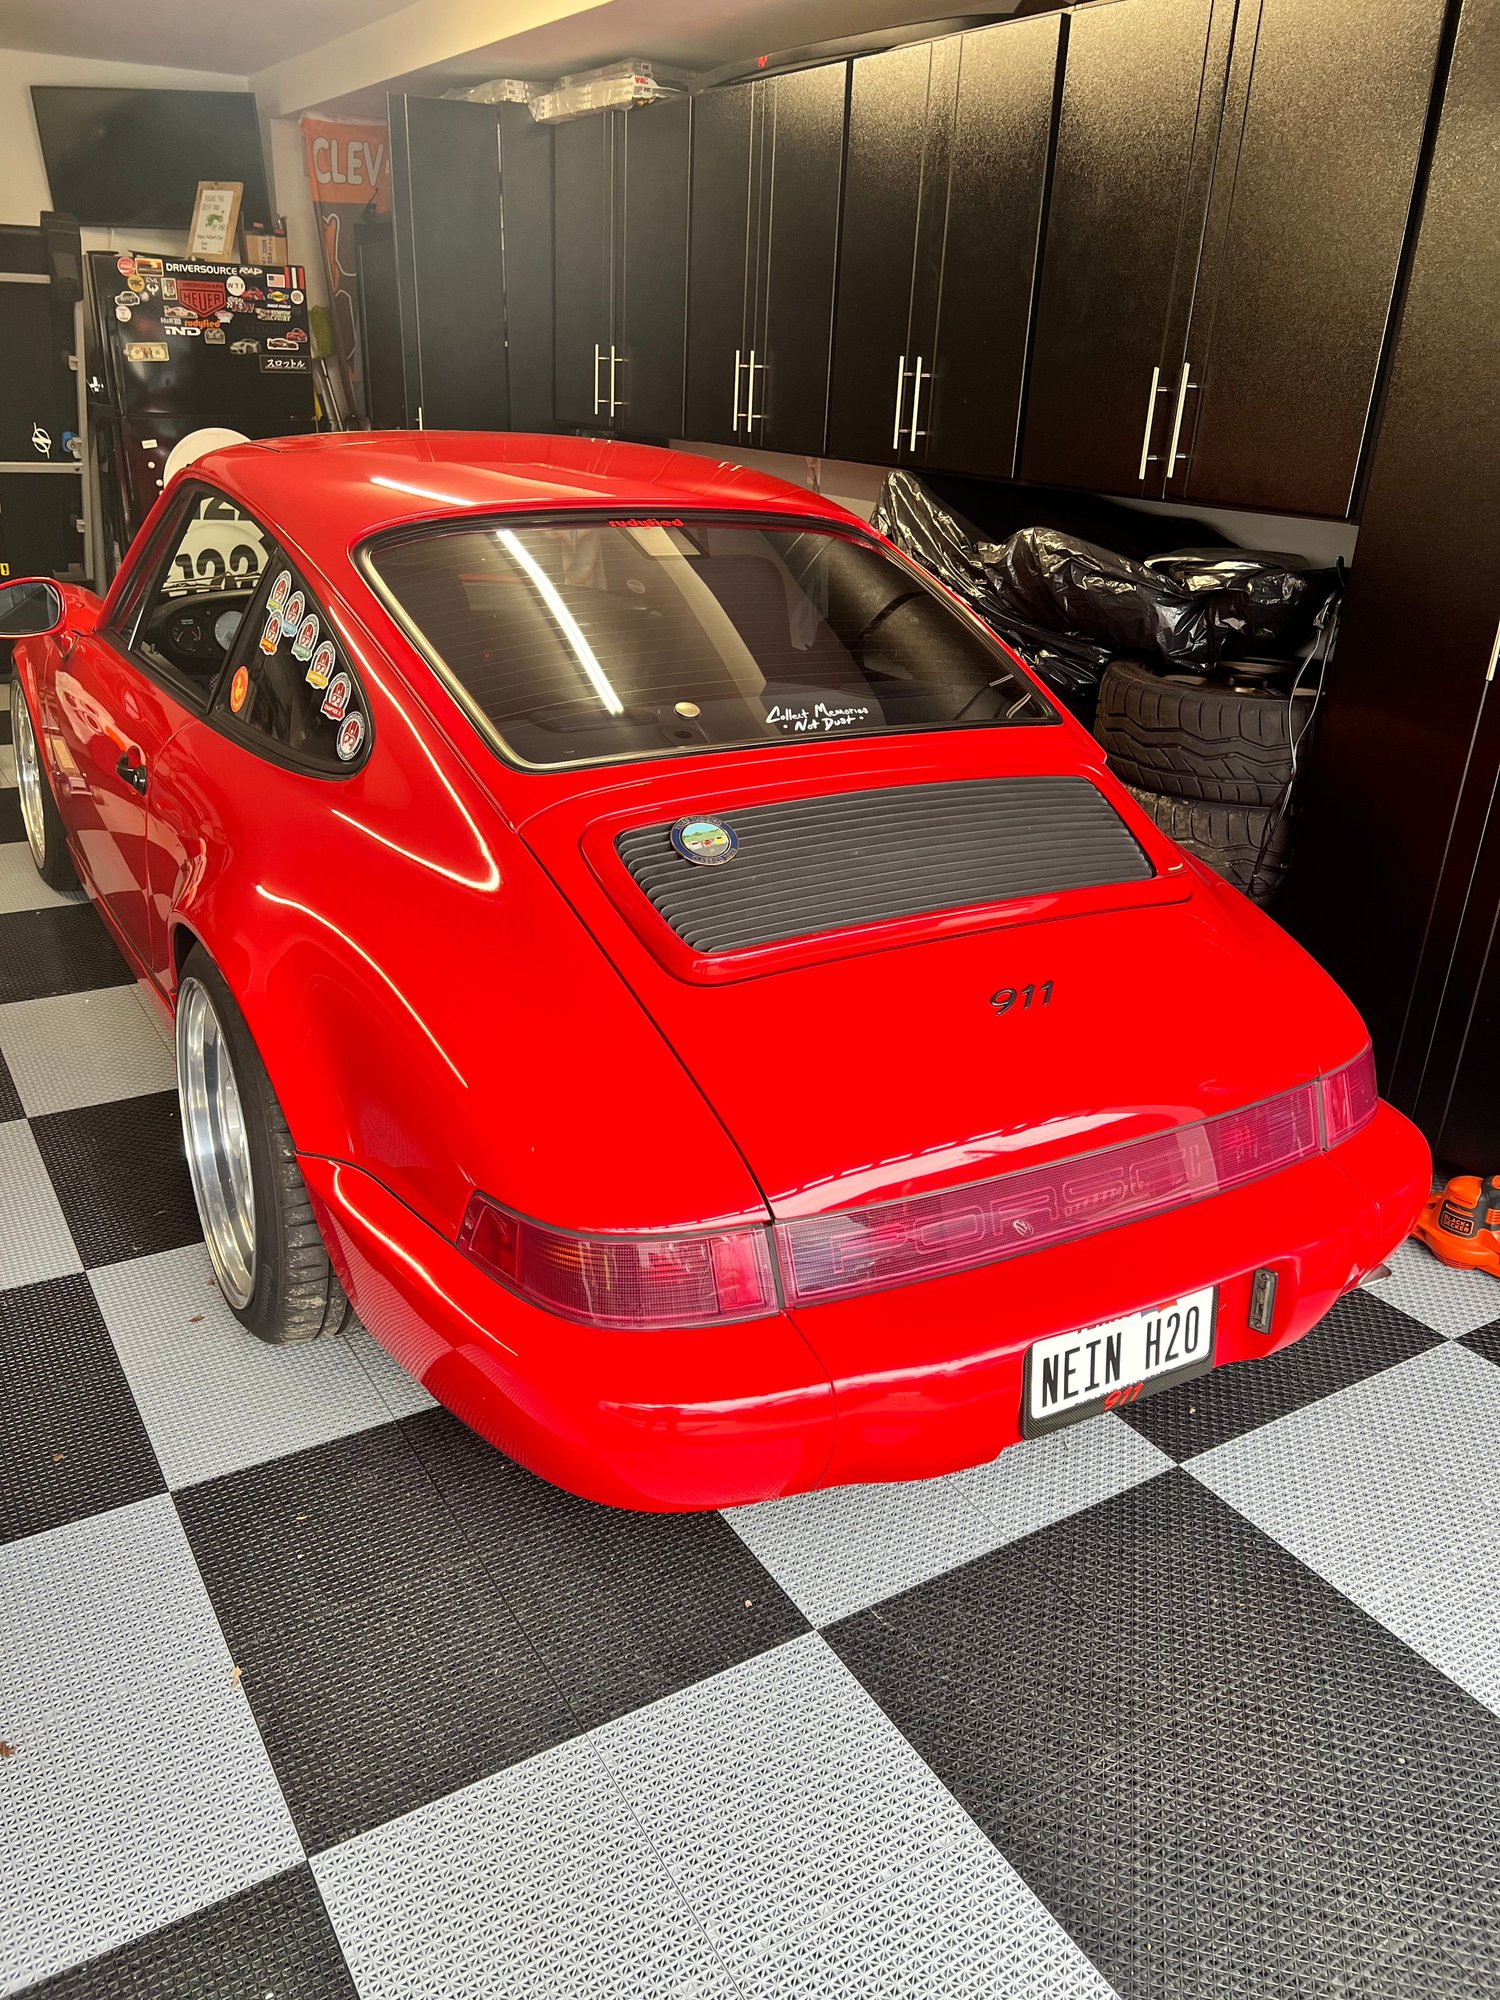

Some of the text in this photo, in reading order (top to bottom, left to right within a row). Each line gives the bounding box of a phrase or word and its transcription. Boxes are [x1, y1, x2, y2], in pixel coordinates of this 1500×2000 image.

[313, 137, 389, 186] CLEV
[165, 263, 237, 275] DRIVERSOURCE
[239, 267, 263, 275] RAD
[183, 292, 221, 312] HEUER
[765, 702, 869, 723] Collect Memories
[794, 715, 856, 731] Not Dust
[989, 980, 1054, 1016] 911
[1443, 1219, 1470, 1233] DECKER
[1041, 1332, 1122, 1409] NEIN
[1104, 1381, 1144, 1411] 911
